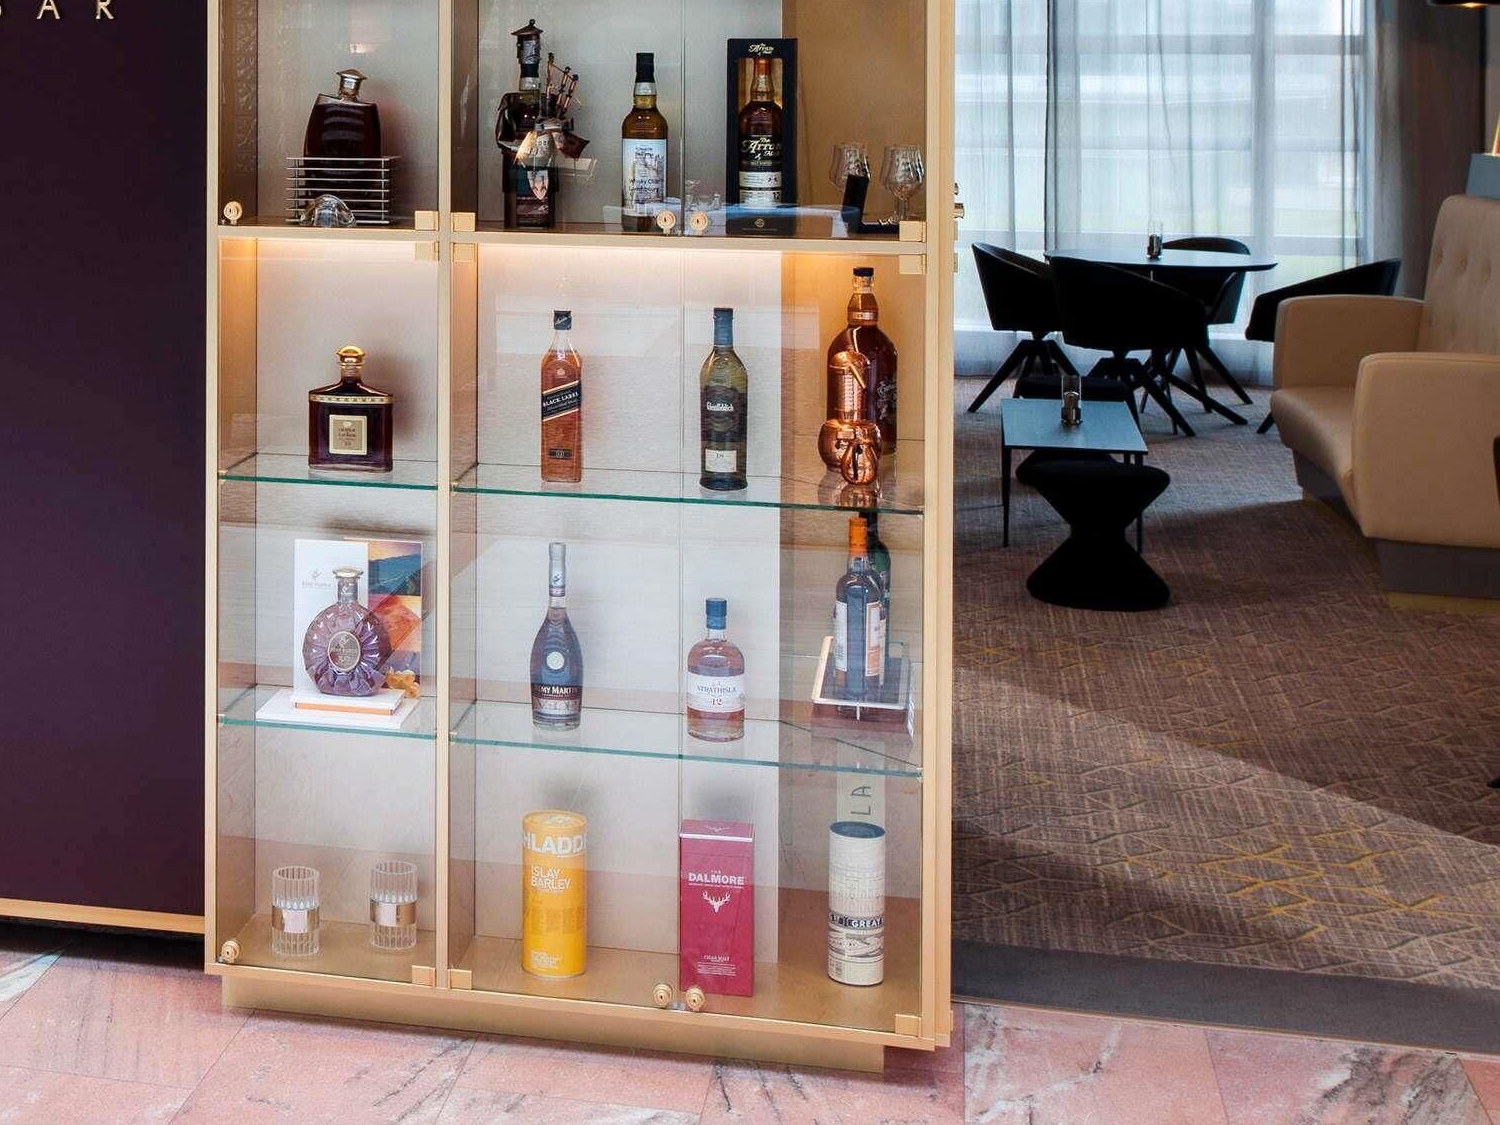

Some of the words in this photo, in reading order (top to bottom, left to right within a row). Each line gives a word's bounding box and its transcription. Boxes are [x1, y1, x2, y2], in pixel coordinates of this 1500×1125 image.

[543, 398, 561, 407] BLACK
[561, 391, 579, 402] LABEL
[531, 865, 562, 879] ISLAY
[688, 872, 745, 886] DALMORE
[531, 877, 572, 891] BARLEY
